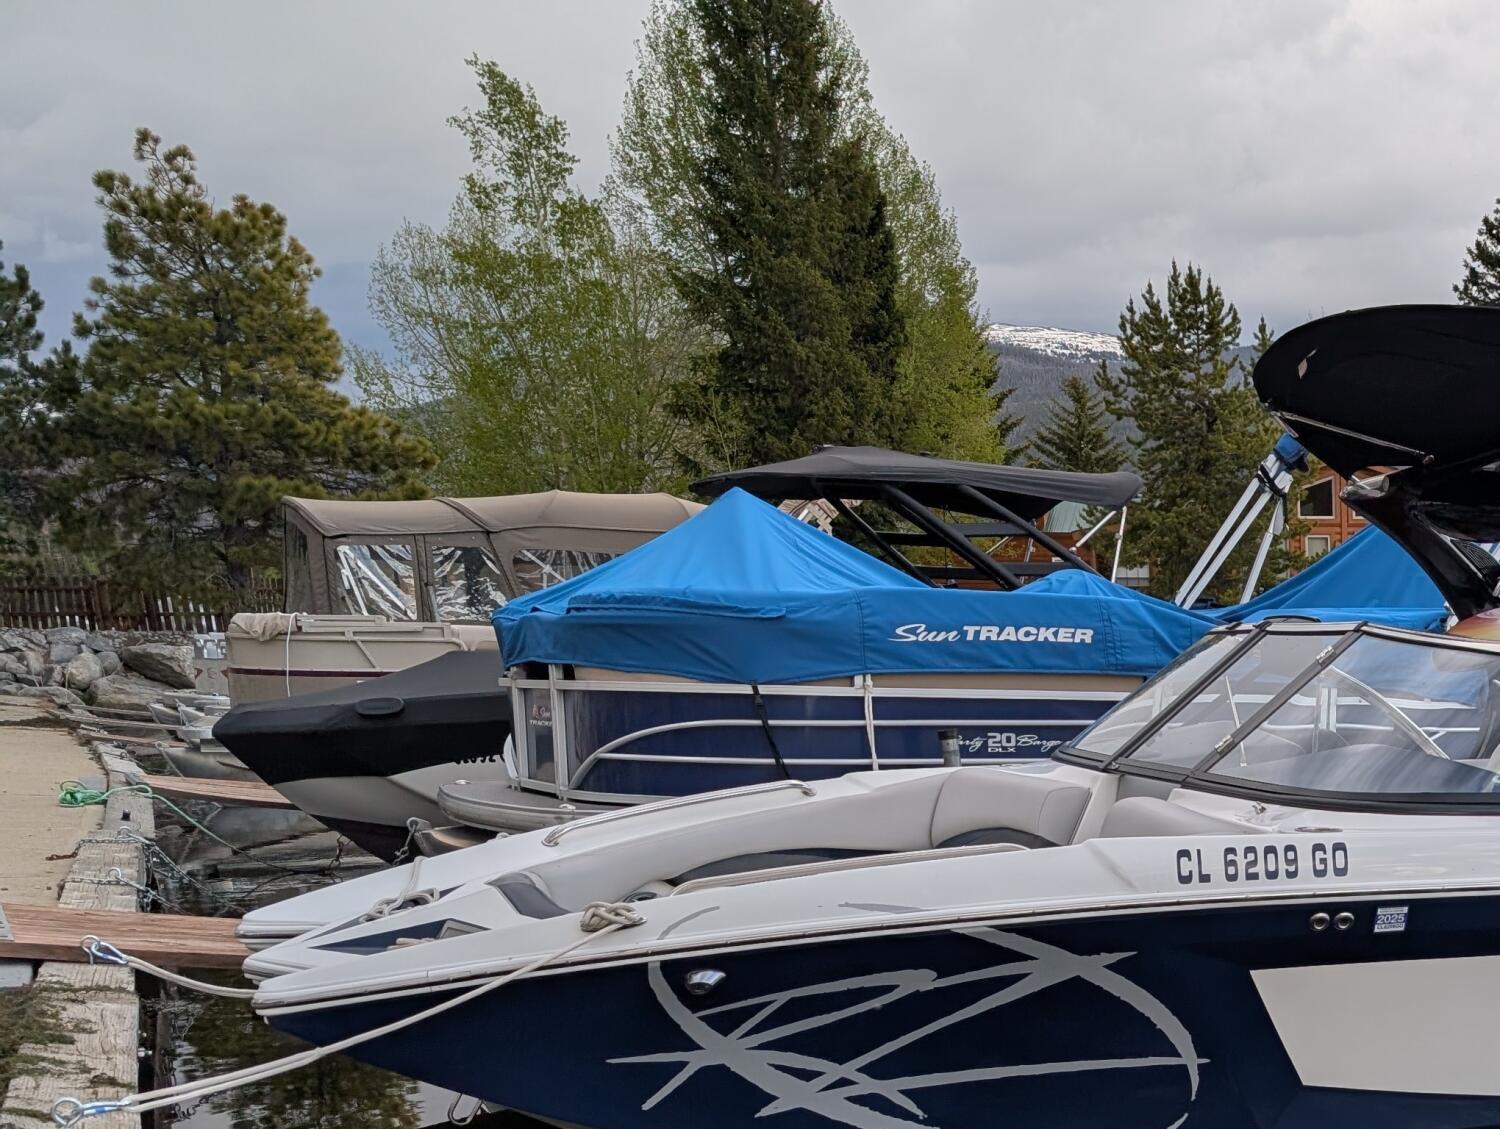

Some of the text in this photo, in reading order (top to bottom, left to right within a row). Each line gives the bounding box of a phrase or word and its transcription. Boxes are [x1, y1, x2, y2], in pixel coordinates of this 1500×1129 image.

[888, 623, 1094, 644] Sun TRACKER
[958, 732, 1063, 753] arty 20 Barge
[1176, 848, 1211, 885] CL
[1223, 844, 1299, 882] 6209
[1376, 913, 1405, 924] 2025
